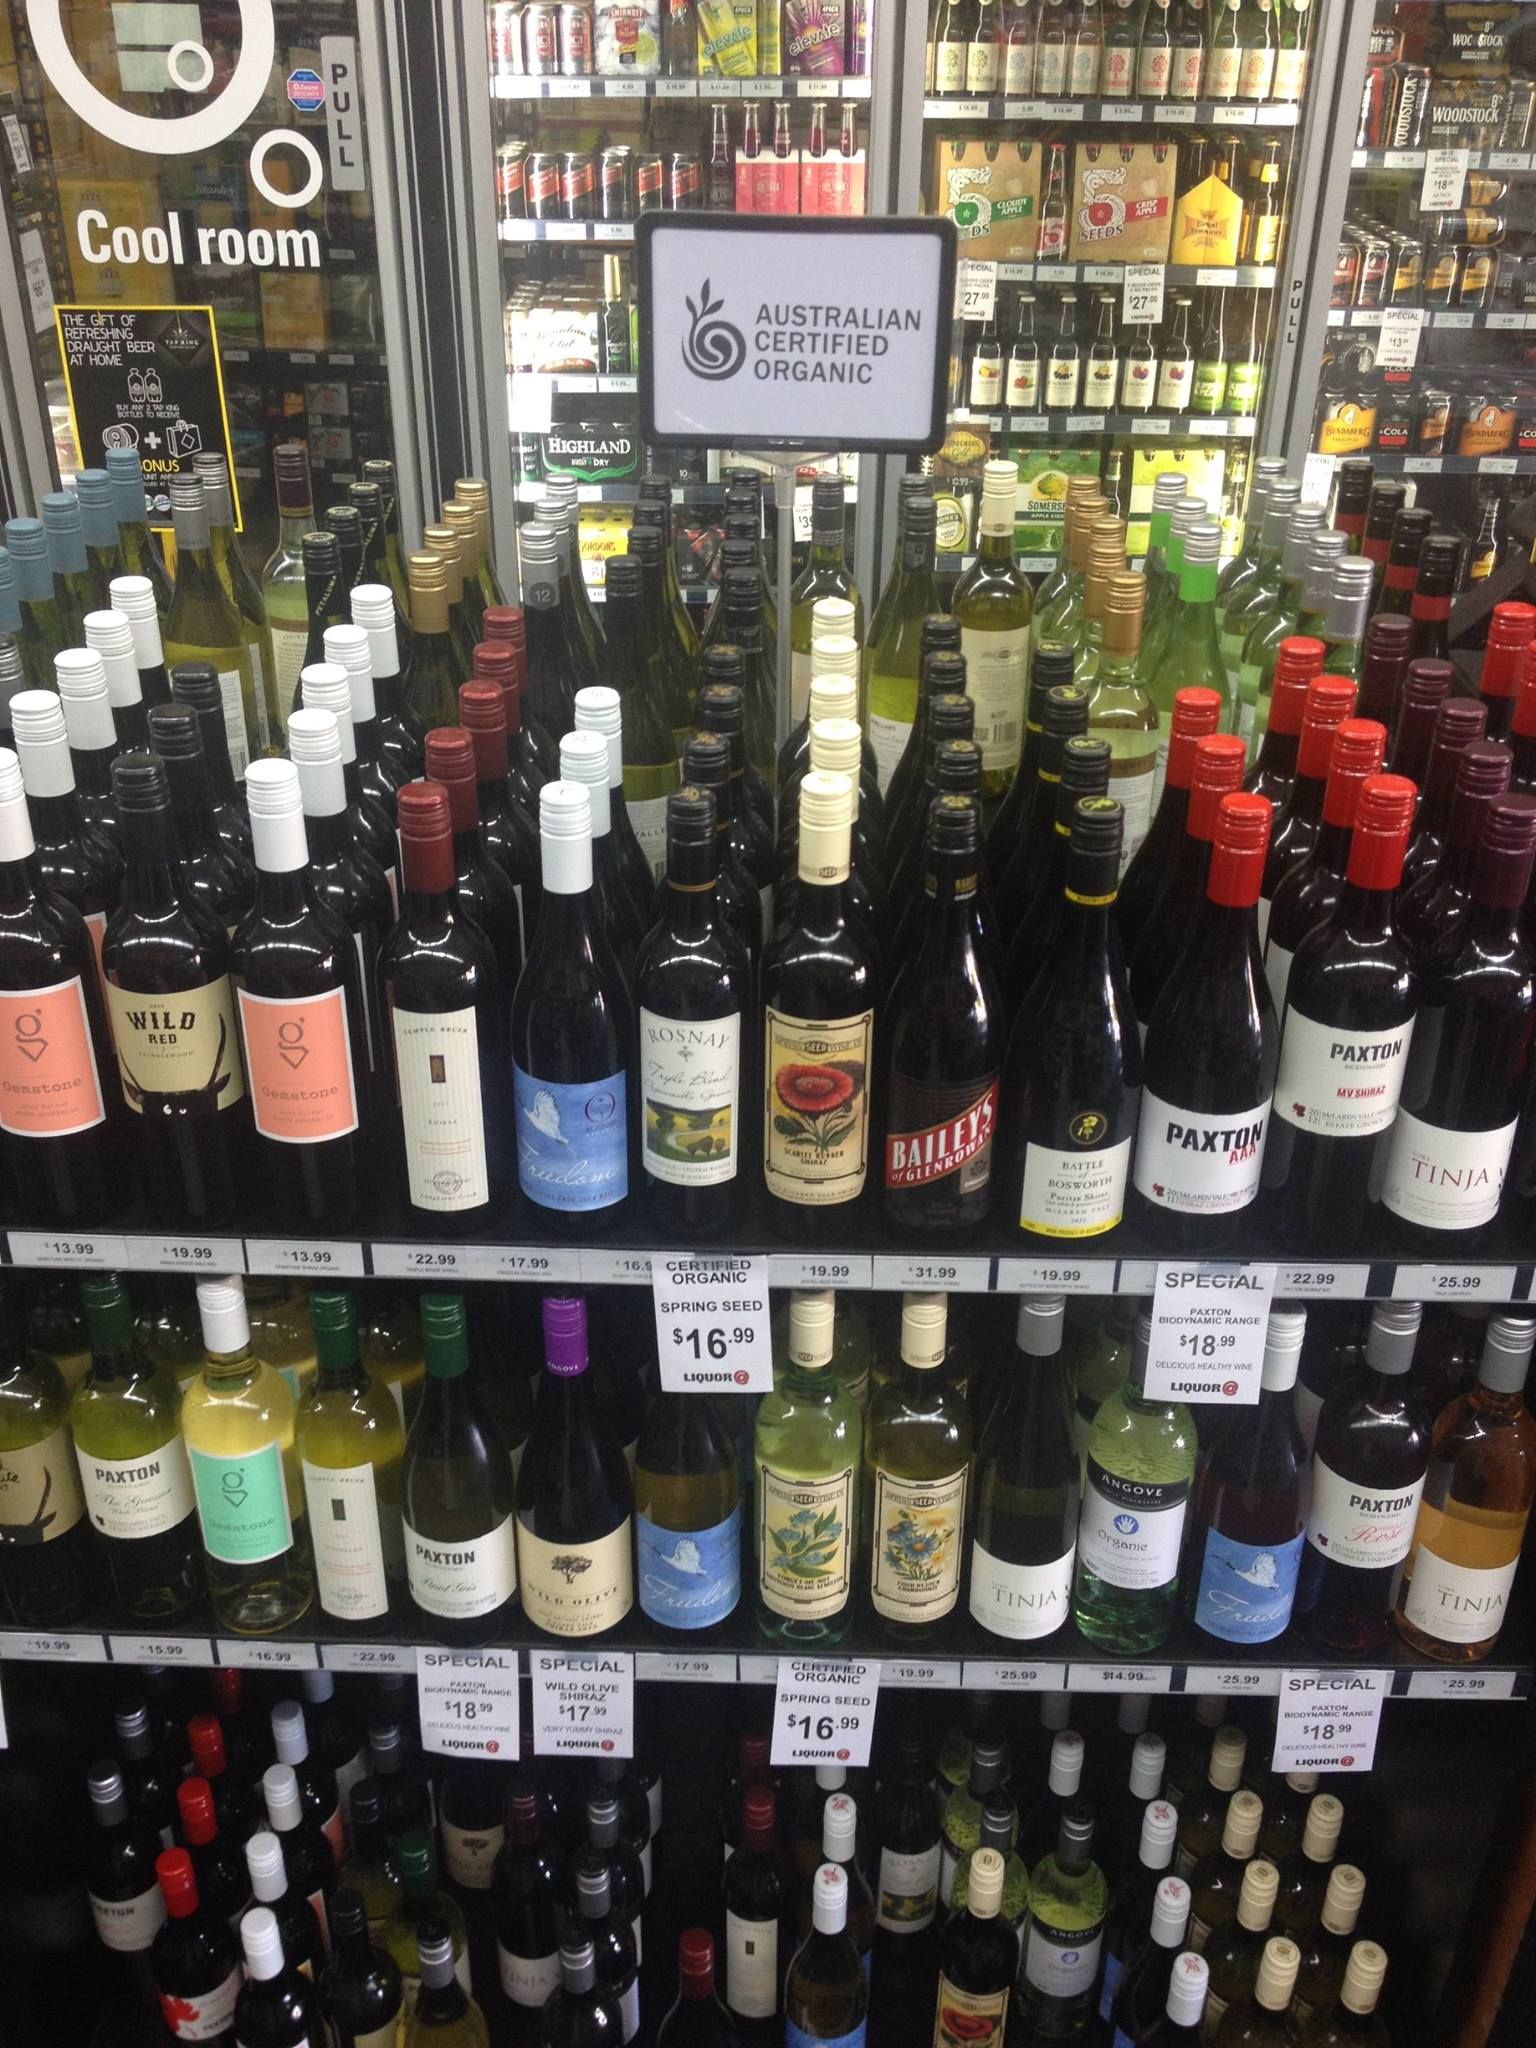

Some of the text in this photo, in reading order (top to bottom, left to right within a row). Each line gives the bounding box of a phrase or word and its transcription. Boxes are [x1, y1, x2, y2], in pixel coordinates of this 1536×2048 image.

[331, 63, 354, 167] PULL
[1432, 107, 1498, 123] WOODSTOCK
[997, 198, 1027, 210] CLOUDY
[1001, 206, 1022, 216] APPLE
[1136, 200, 1158, 209] CRISP
[1135, 208, 1157, 216] APPLE
[77, 209, 320, 267] Cool room
[1081, 226, 1123, 241] SEEDS
[966, 263, 993, 273] PECIAL
[1128, 267, 1160, 276] SPECIAL
[755, 303, 921, 331] AUSTRALIAN
[1287, 280, 1303, 343] PULL
[1387, 312, 1419, 321] SPECIAL
[63, 315, 136, 326] THE GIFT OF
[66, 328, 133, 339] REFRESHING
[67, 341, 155, 352] DRAUGHT BEER
[755, 331, 888, 356] CERTIFIED
[70, 355, 122, 366] AT HOME
[754, 359, 872, 384] ORGANIC
[1326, 425, 1370, 436] BUNDABERG
[549, 435, 631, 455] HIGHLAND
[140, 459, 180, 471] ONUS
[594, 459, 609, 467] DRY
[534, 589, 551, 601] 12
[125, 1011, 196, 1030] WILD
[148, 1034, 177, 1044] RED
[648, 1027, 730, 1048] ROSNAY
[1330, 1038, 1403, 1062] PAXTON
[3, 1077, 82, 1095] Gemstone
[1337, 1085, 1386, 1098] MV SHIRAZ
[262, 1086, 338, 1102] Gemstone
[892, 1093, 993, 1170] BAILEYS
[1166, 1120, 1263, 1152] PAXTON
[892, 1124, 991, 1182] of GLENROWAN
[1229, 1143, 1256, 1165] AAA
[1062, 1160, 1104, 1170] BATTLE
[1412, 1157, 1489, 1192] TINJA
[1048, 1176, 1112, 1189] BOSWORTH
[408, 1253, 456, 1265] $22.99
[501, 1257, 549, 1269] $17.99
[666, 1259, 751, 1272] CERTIFIED
[802, 1264, 849, 1277] $19.99
[908, 1265, 957, 1279] $31.99
[1033, 1269, 1081, 1282] $19.99
[672, 1271, 747, 1285] ORGANIC
[1164, 1271, 1265, 1291] SPECIAL
[1285, 1272, 1335, 1286] $22.99
[1431, 1275, 1481, 1289] $25.99
[661, 1300, 762, 1313] SPRING SEED
[1190, 1307, 1231, 1317] PAXTON
[1159, 1315, 1261, 1326] BIODYNAMIC RANGE
[673, 1328, 754, 1360] $16.99
[1180, 1334, 1235, 1356] $18.99
[1155, 1361, 1253, 1371] DELICIOUS HEALTHY WINE
[95, 1461, 160, 1484] PAXTON
[1102, 1473, 1164, 1497] ANGOVE
[1350, 1494, 1413, 1513] PAXTON
[1098, 1528, 1148, 1552] Organic
[416, 1544, 475, 1565] PAXTON
[573, 1584, 619, 1606] OLIVE
[992, 1584, 1057, 1609] TINJA
[1437, 1587, 1503, 1613] TINJA
[424, 1653, 510, 1669] SPECIAL
[540, 1657, 624, 1673] SPECIAL
[791, 1661, 866, 1675] CERTIFIED
[794, 1672, 861, 1685] ORGANIC
[1102, 1671, 1144, 1681] $14.99
[545, 1681, 619, 1693] WILD OLIVE
[1288, 1678, 1376, 1690] SPECIAL
[424, 1686, 512, 1697] BIODYNAMIC RANGE
[559, 1692, 606, 1701] SHIRAZ
[780, 1693, 871, 1707] SPRING SEED
[444, 1700, 493, 1719] $18.99
[559, 1703, 607, 1721] $17.99
[543, 1725, 624, 1735] VERY YUMMY SHIRAZ
[787, 1713, 860, 1740] $16.99
[1303, 1723, 1352, 1740] $18.99
